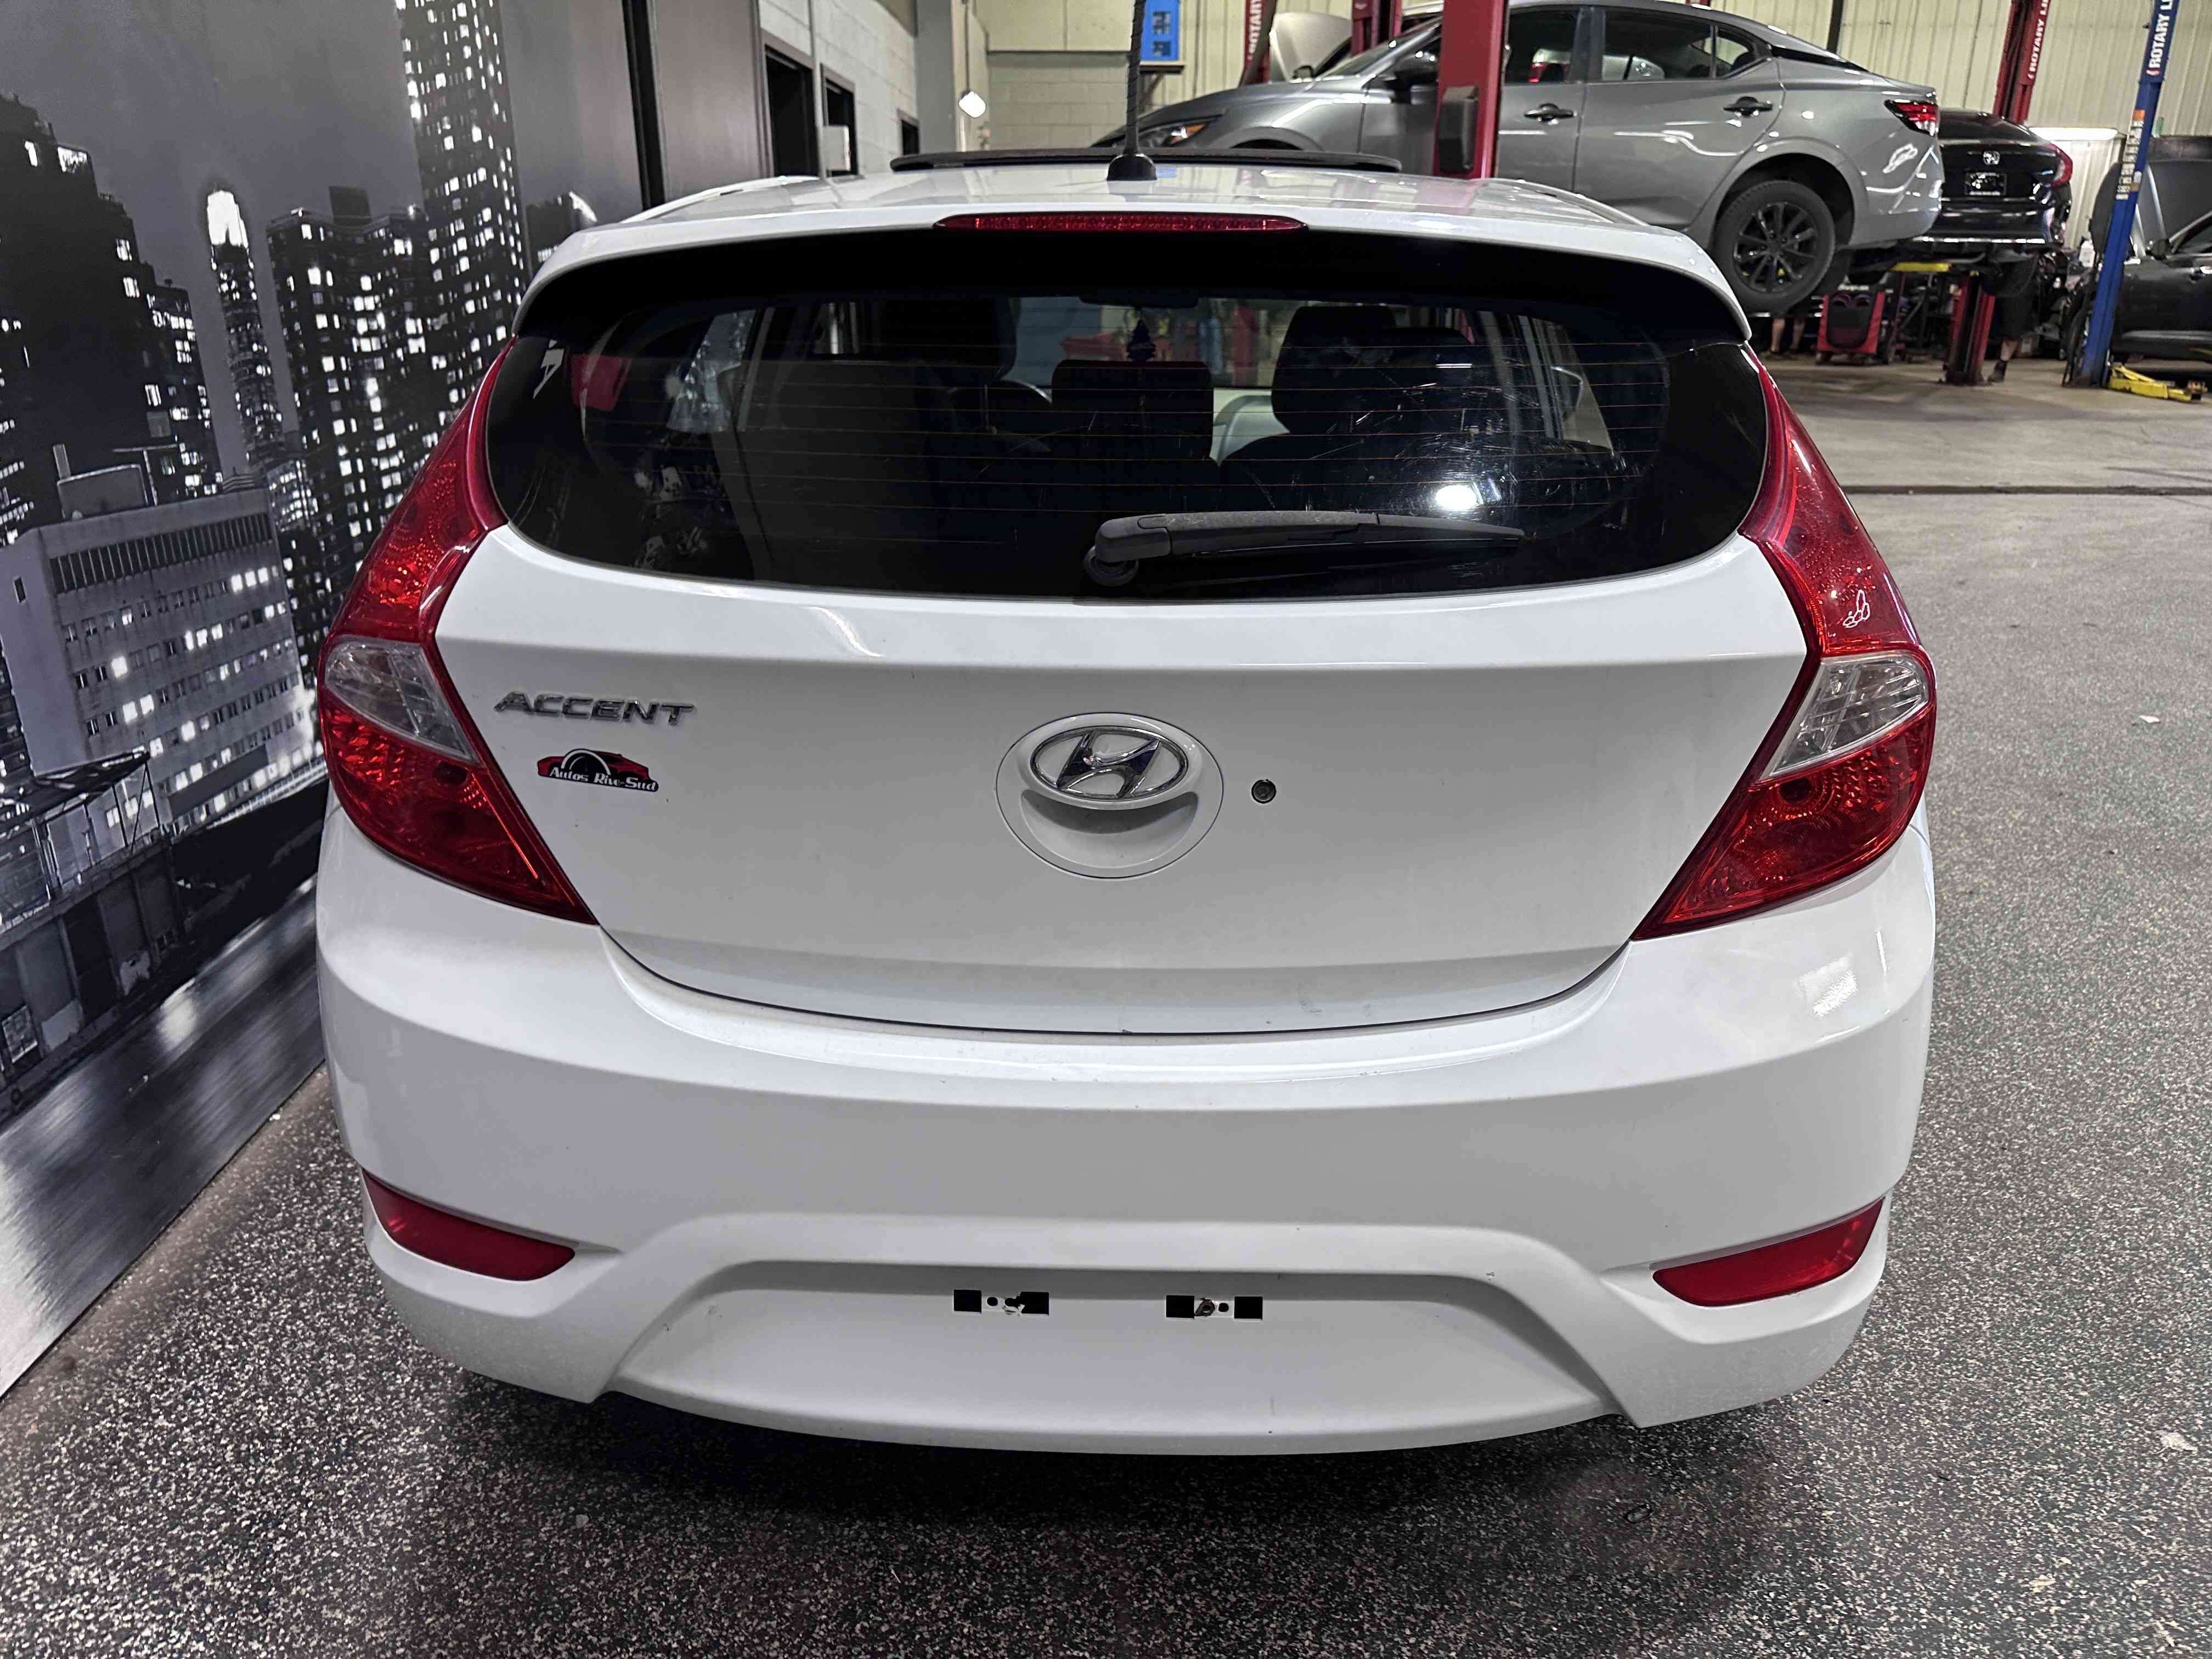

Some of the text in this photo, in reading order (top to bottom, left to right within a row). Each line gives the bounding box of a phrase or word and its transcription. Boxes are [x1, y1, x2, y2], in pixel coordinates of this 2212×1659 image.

[2029, 18, 2045, 72] ROTARY
[2148, 14, 2170, 68] ROTARY
[494, 691, 695, 725] ACCENT
[550, 767, 658, 791] Autos Rive-Sud
